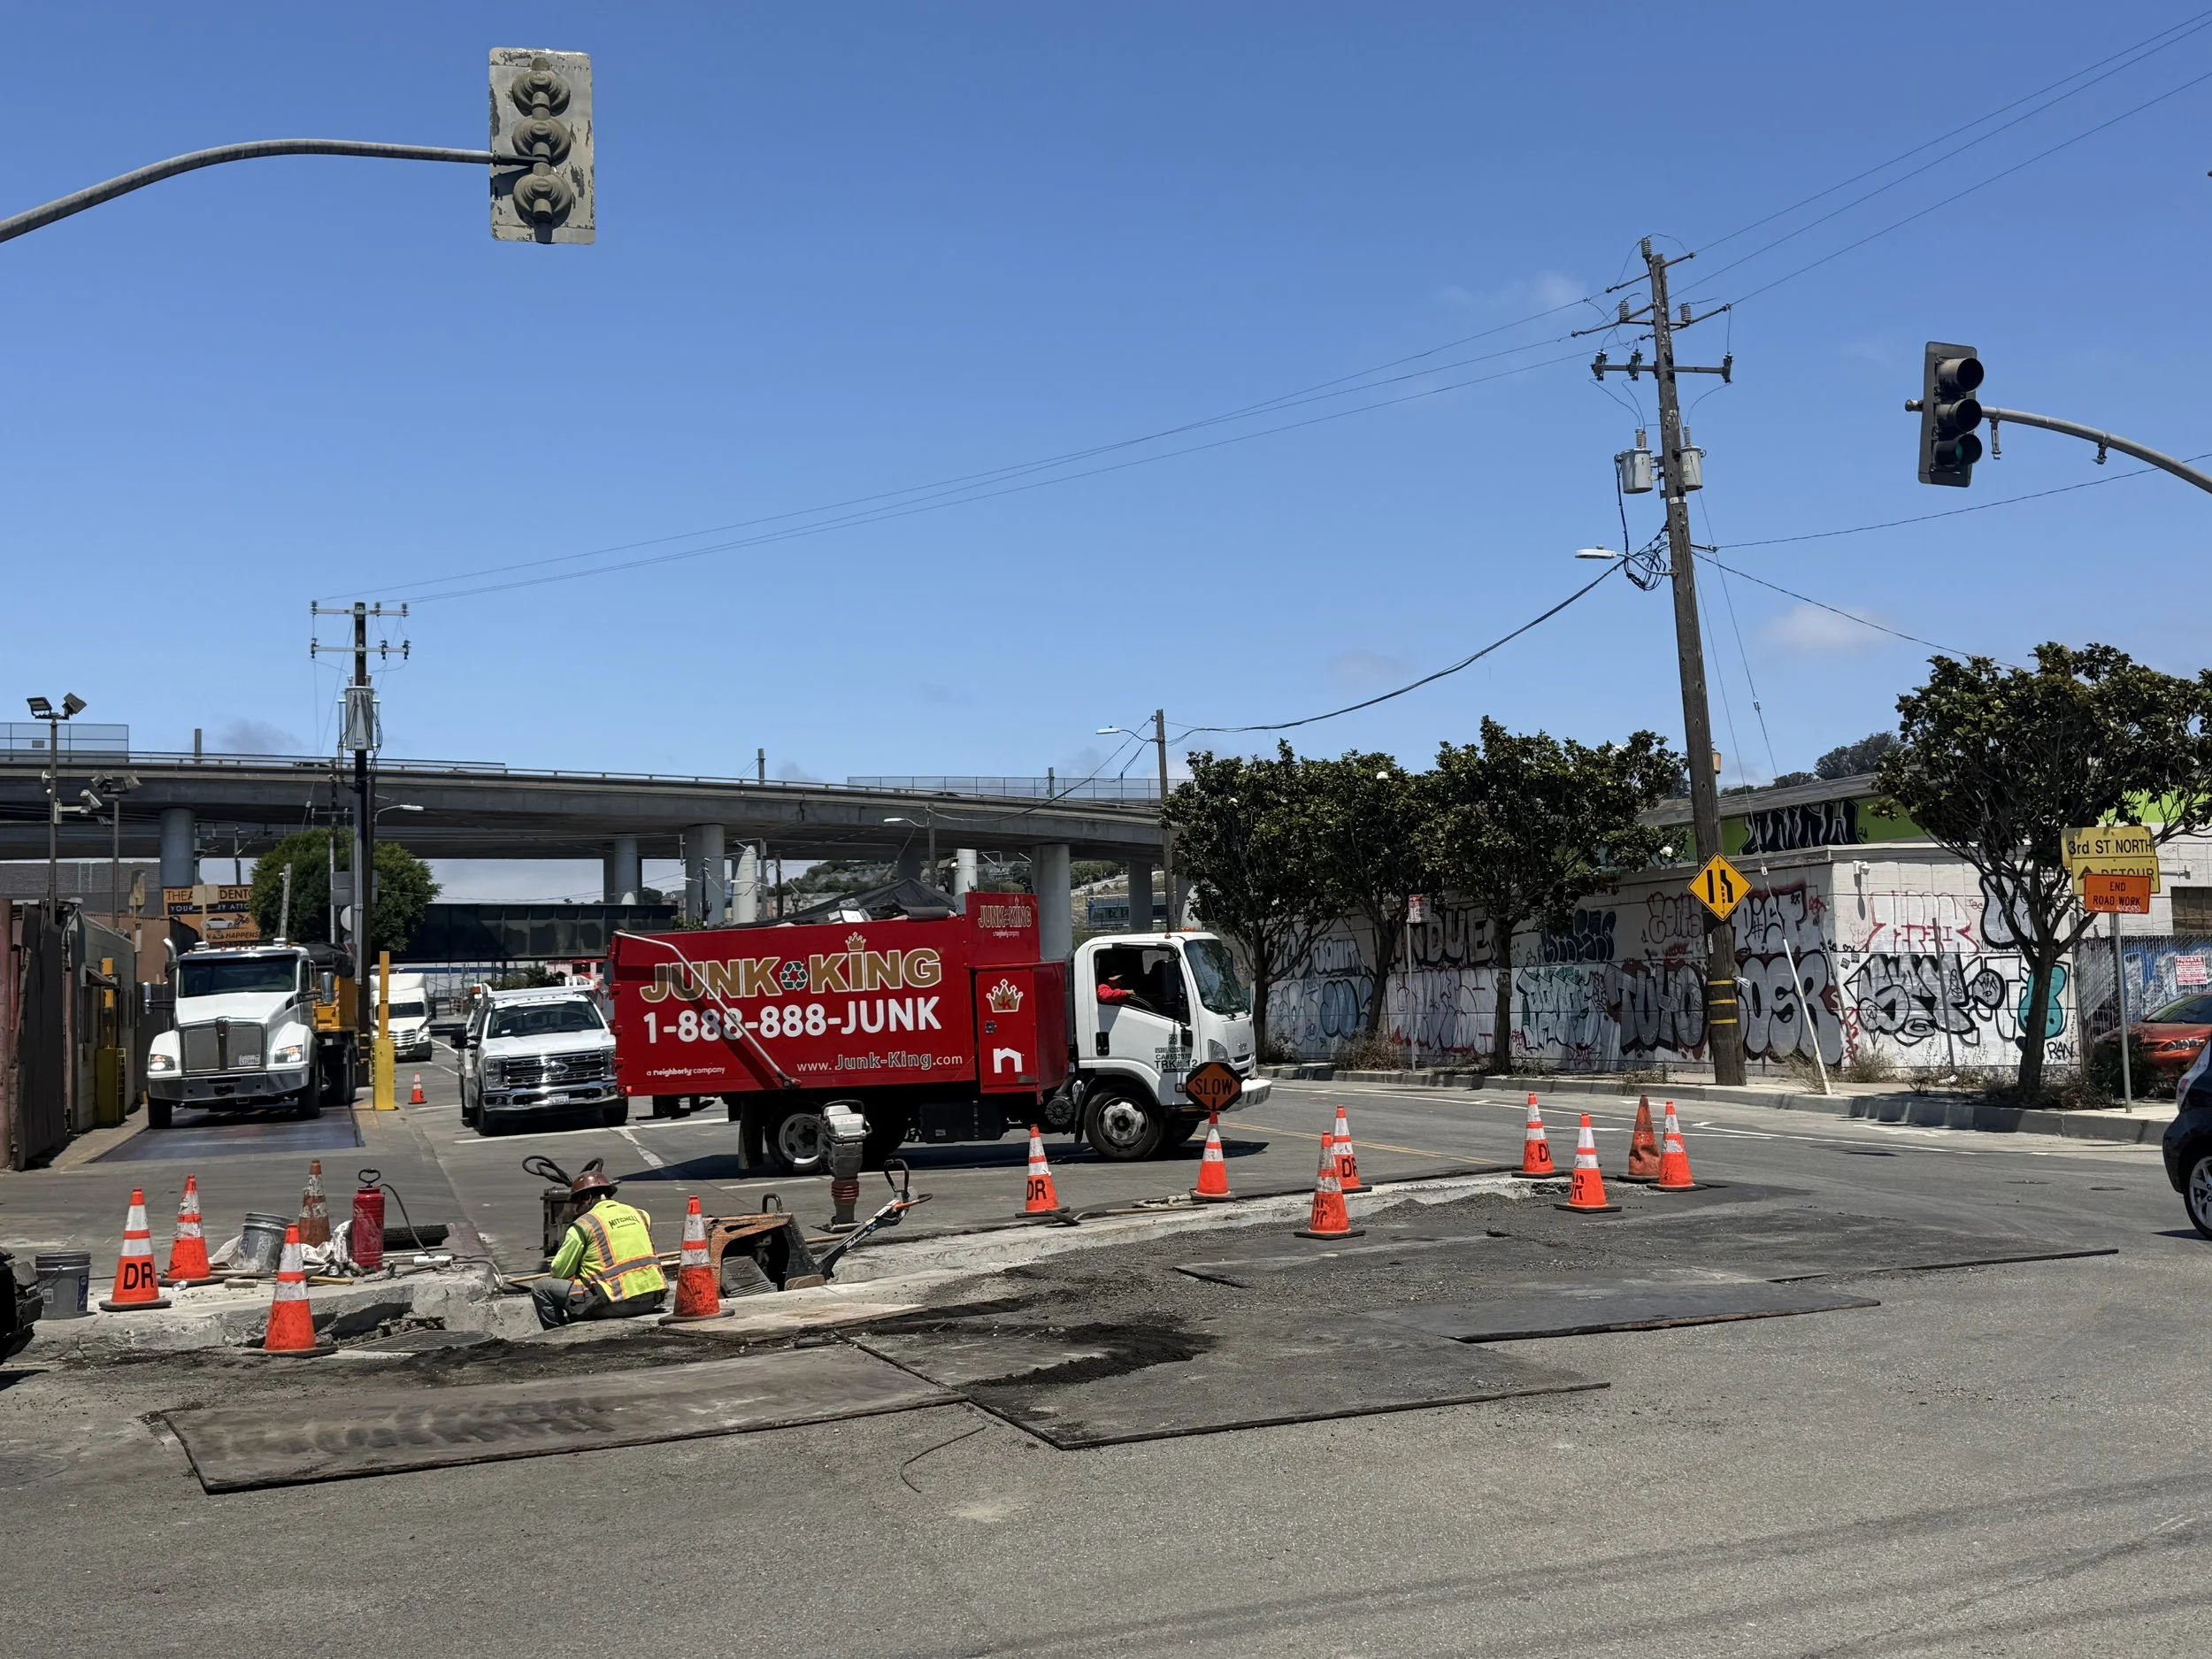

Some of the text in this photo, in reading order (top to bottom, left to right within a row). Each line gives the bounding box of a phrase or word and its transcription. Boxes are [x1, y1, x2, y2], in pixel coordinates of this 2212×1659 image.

[2068, 839, 2152, 855] 3rd ST NORTH
[2109, 881, 2126, 892] END
[170, 904, 194, 913] YOUR
[2093, 895, 2140, 907] ROAD WORK
[978, 904, 1033, 928] JUNK KING
[639, 948, 942, 1003] JUNK KING
[643, 995, 942, 1044] 1-888-888-JUNK
[1186, 1058, 1198, 1068] 12
[653, 1067, 692, 1078] neighborly
[693, 1066, 726, 1075] company
[1194, 1078, 1233, 1095] SLOW
[1026, 1179, 1047, 1202] DR
[123, 1261, 155, 1290] DR
